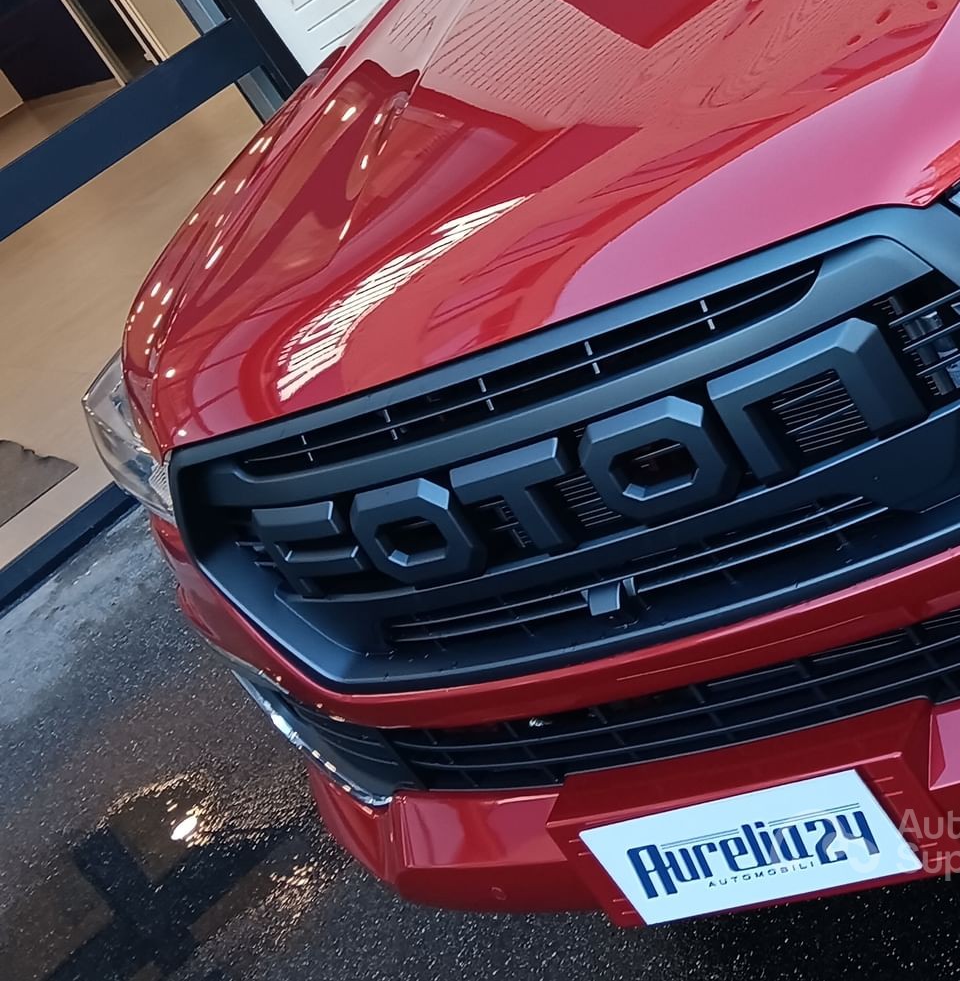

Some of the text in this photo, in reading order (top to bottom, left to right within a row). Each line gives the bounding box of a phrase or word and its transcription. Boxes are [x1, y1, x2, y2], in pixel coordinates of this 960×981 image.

[251, 317, 929, 599] FOTON
[626, 810, 881, 900] Aurelia24
[708, 860, 815, 888] AUTOMOBILI
